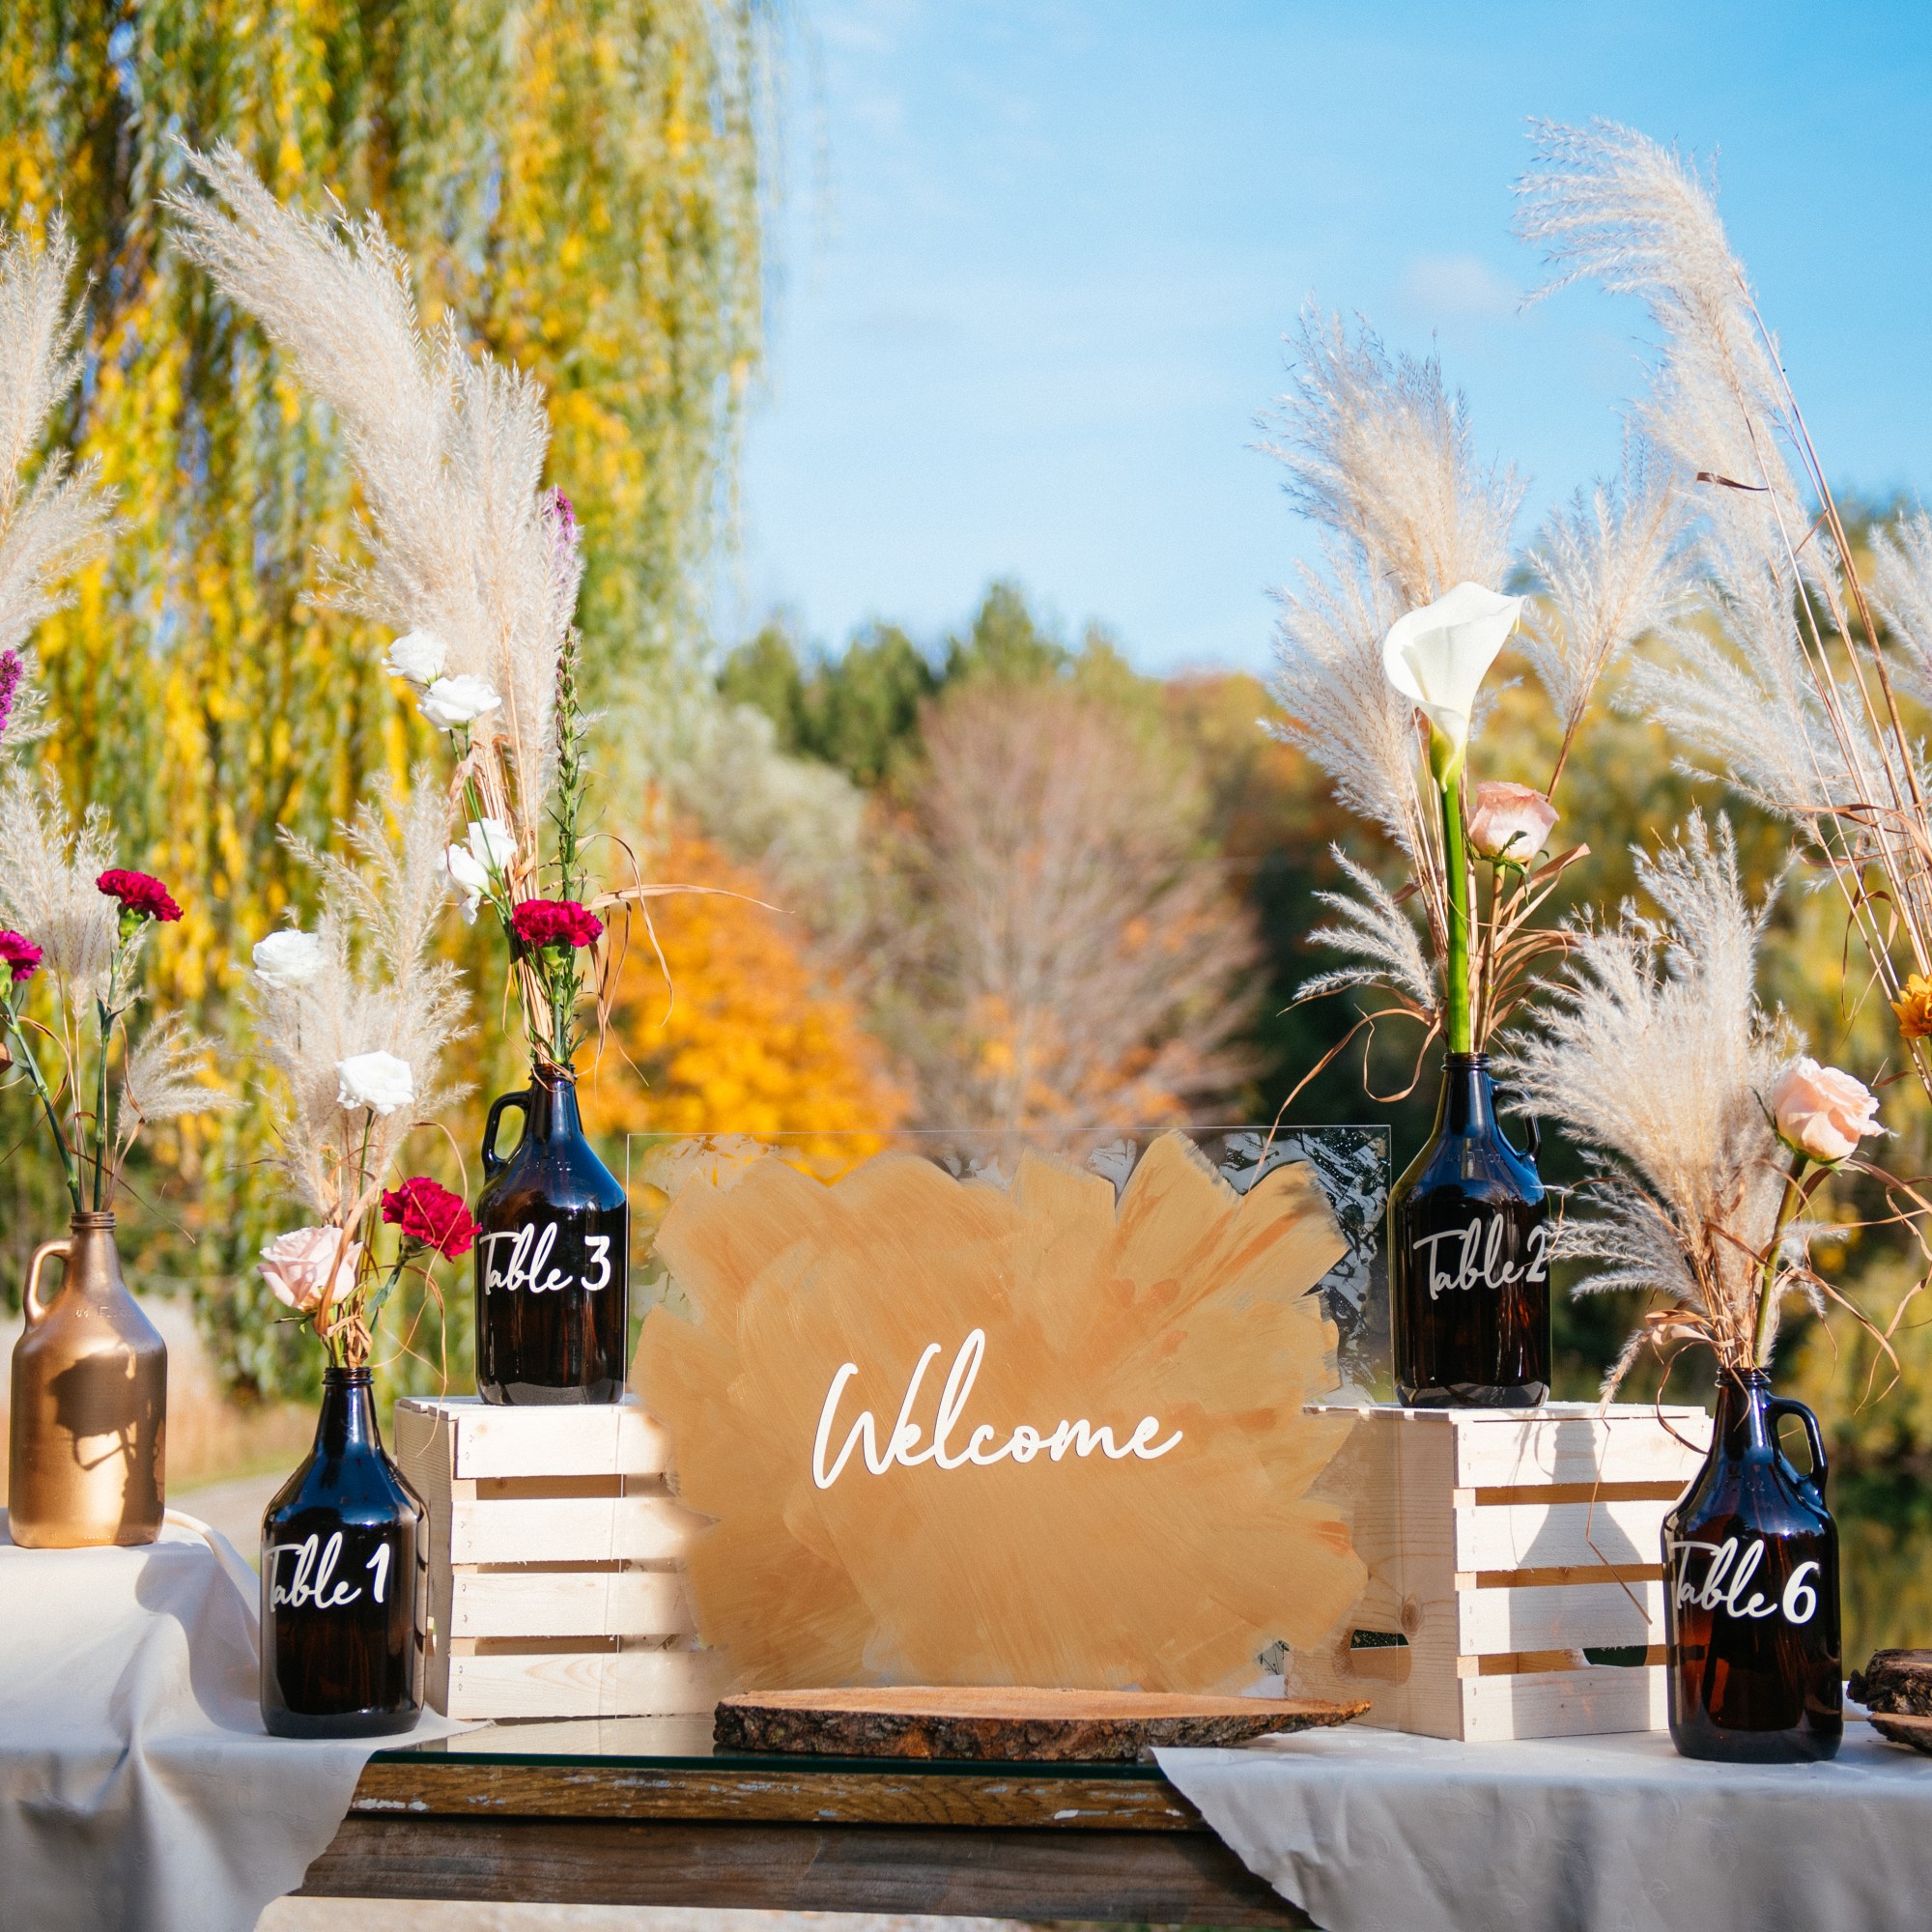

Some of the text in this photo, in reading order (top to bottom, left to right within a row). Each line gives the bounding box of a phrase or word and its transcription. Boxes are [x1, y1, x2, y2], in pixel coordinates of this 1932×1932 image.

[479, 1222, 611, 1294] Table 3
[1413, 1213, 1546, 1300] Table 2
[812, 1328, 1183, 1489] Welcome
[265, 1531, 389, 1612] Table 1
[1671, 1537, 1820, 1623] Table 6
